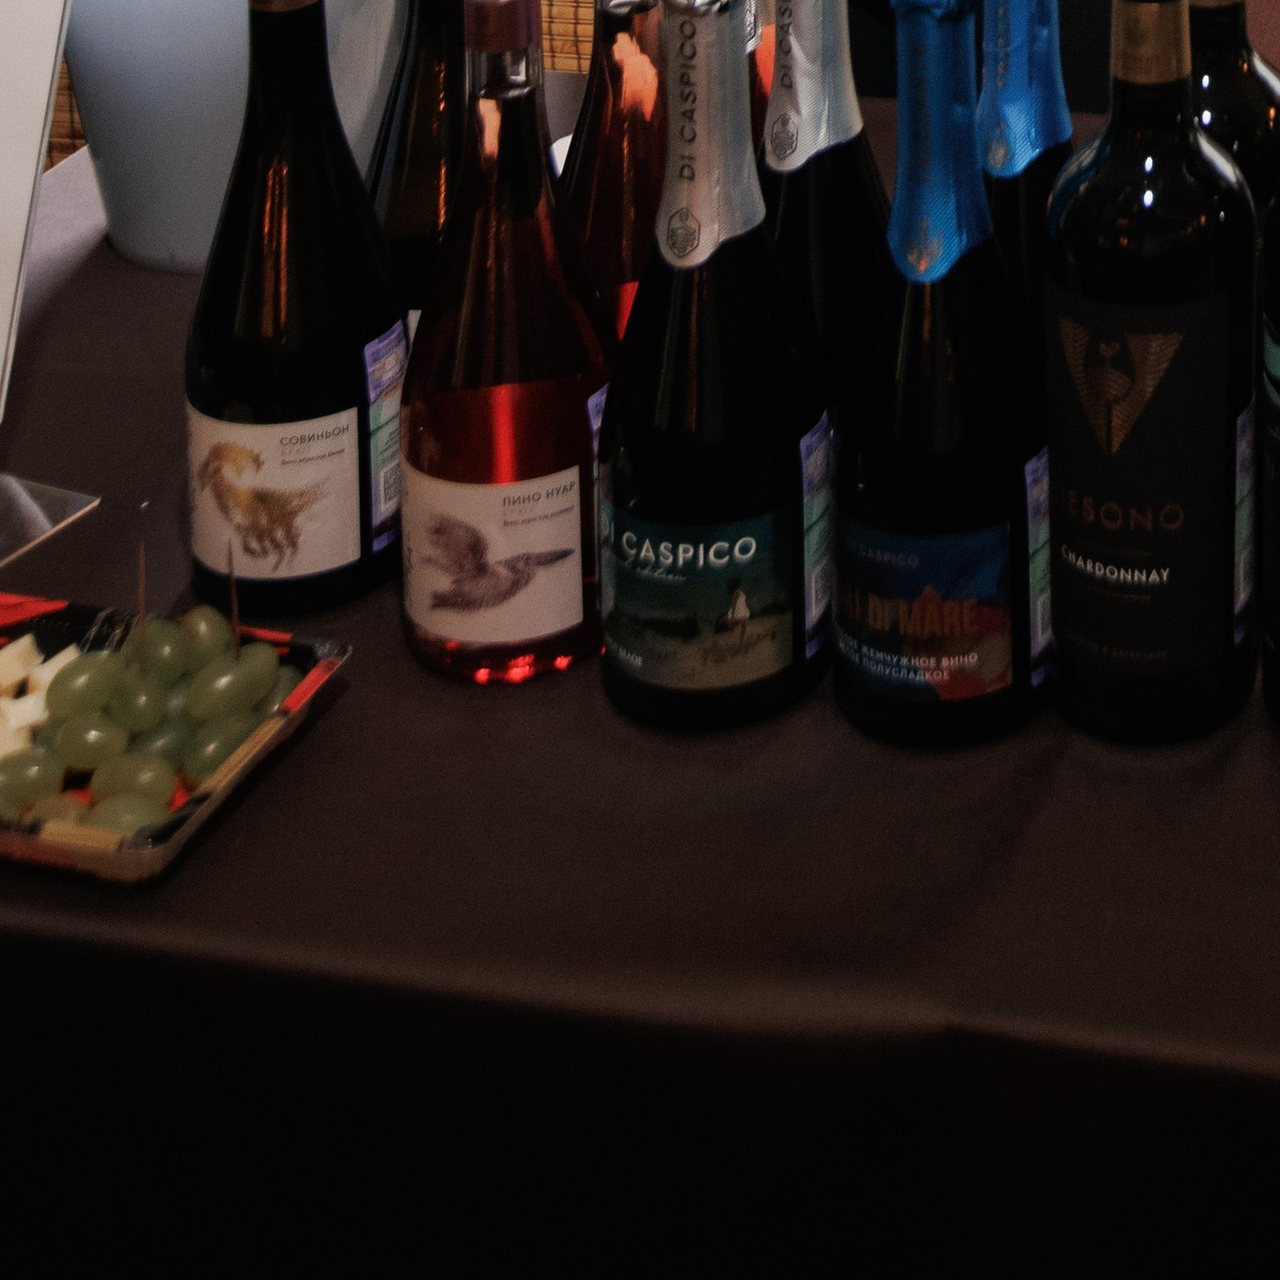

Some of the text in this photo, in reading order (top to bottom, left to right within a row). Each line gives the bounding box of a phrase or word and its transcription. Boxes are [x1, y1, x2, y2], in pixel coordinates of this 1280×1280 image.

[679, 18, 698, 181] DI CASPICO
[280, 423, 350, 446] СОВИНЬОН
[502, 480, 576, 506] ПИНО НУАР
[622, 531, 757, 567] CASPICO
[1061, 544, 1170, 585] CHARDONNAY
